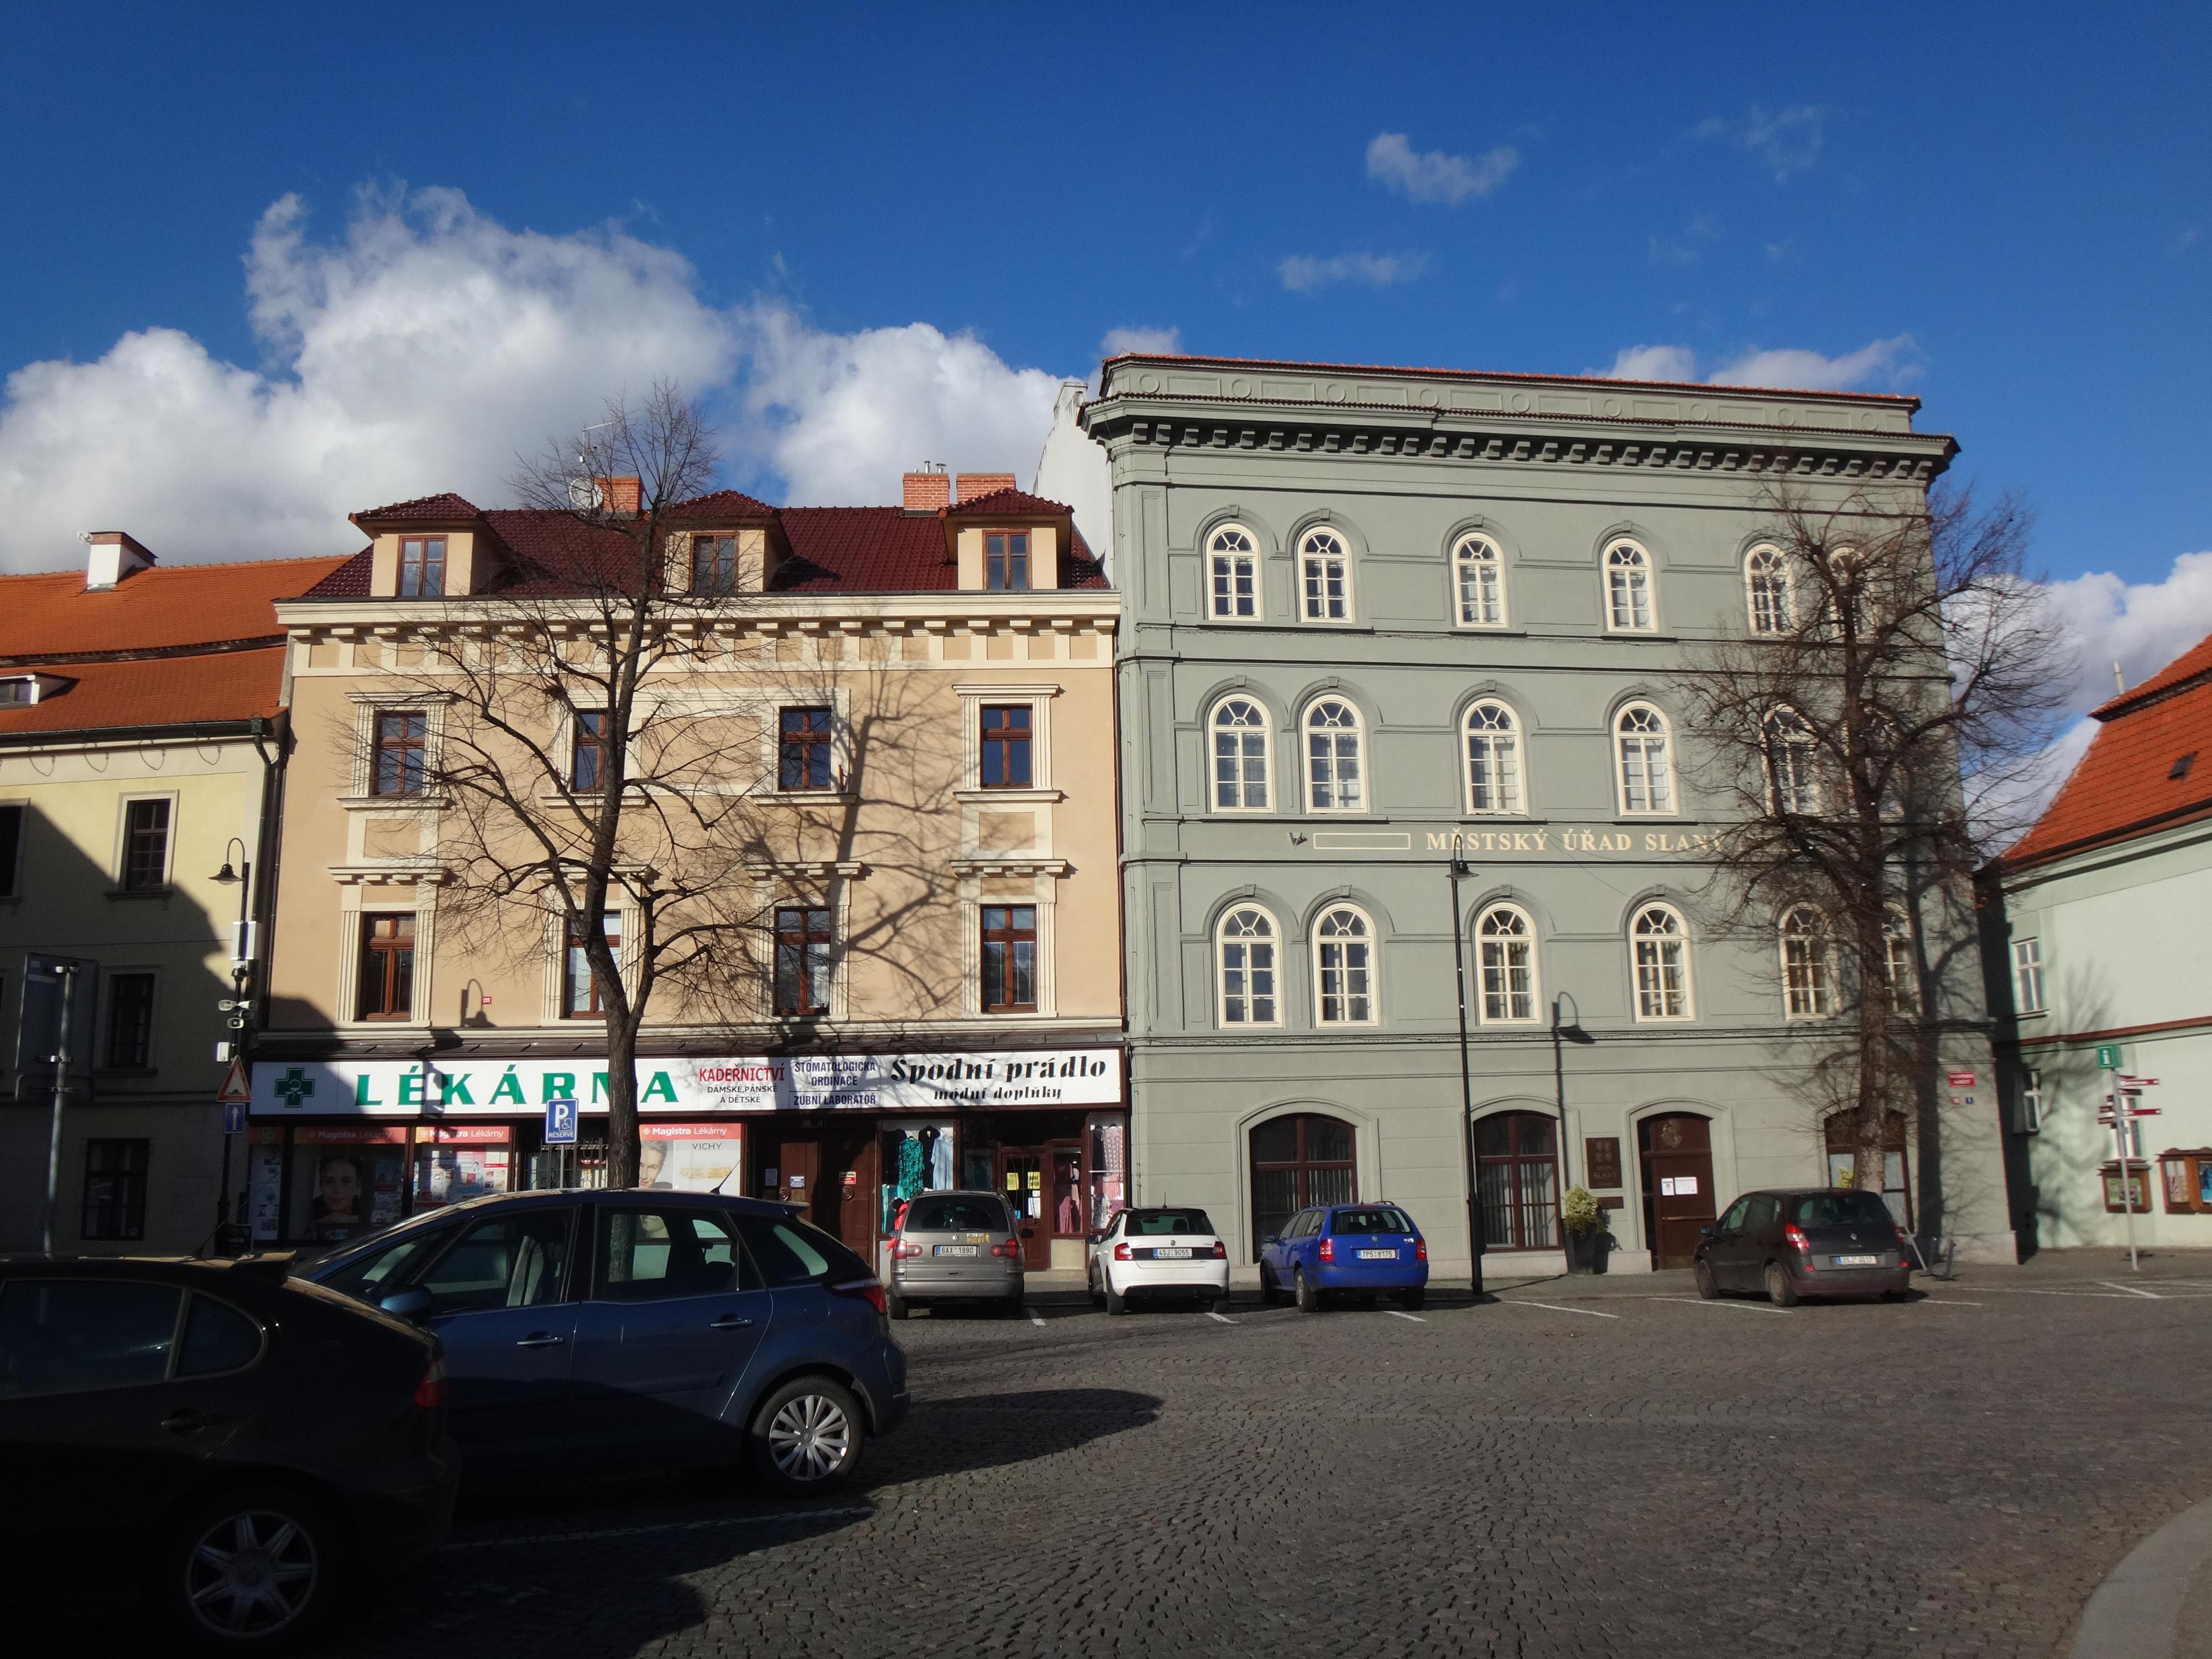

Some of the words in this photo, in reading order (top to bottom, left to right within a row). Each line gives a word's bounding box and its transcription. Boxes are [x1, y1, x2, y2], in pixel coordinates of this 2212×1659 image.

[1426, 827, 1548, 851] MĚSTSKÝ
[1562, 828, 1632, 851] ÚŘAD
[1645, 830, 1726, 851] SLANÝ
[795, 1061, 876, 1072] STOMATOLOGICKÁ
[891, 1058, 996, 1084] Spodní
[1006, 1055, 1107, 1082] prádlo
[699, 1063, 785, 1082] KADEŘNICTVÍ
[812, 1076, 858, 1086] ORDINACE
[728, 1094, 760, 1103] DĚTSKÉ
[934, 1087, 987, 1100] módní
[994, 1086, 1061, 1100] doplňky
[794, 1094, 821, 1105] ZUBNÍ
[824, 1093, 876, 1105] LABORATOŘ
[555, 1104, 568, 1128] P
[317, 1130, 356, 1140] Magistra
[359, 1130, 392, 1140] Lékárny
[429, 1130, 468, 1139] Magistra
[471, 1129, 503, 1138] Lékárny
[653, 1127, 691, 1135] Magistra
[694, 1127, 727, 1135] Lékárny
